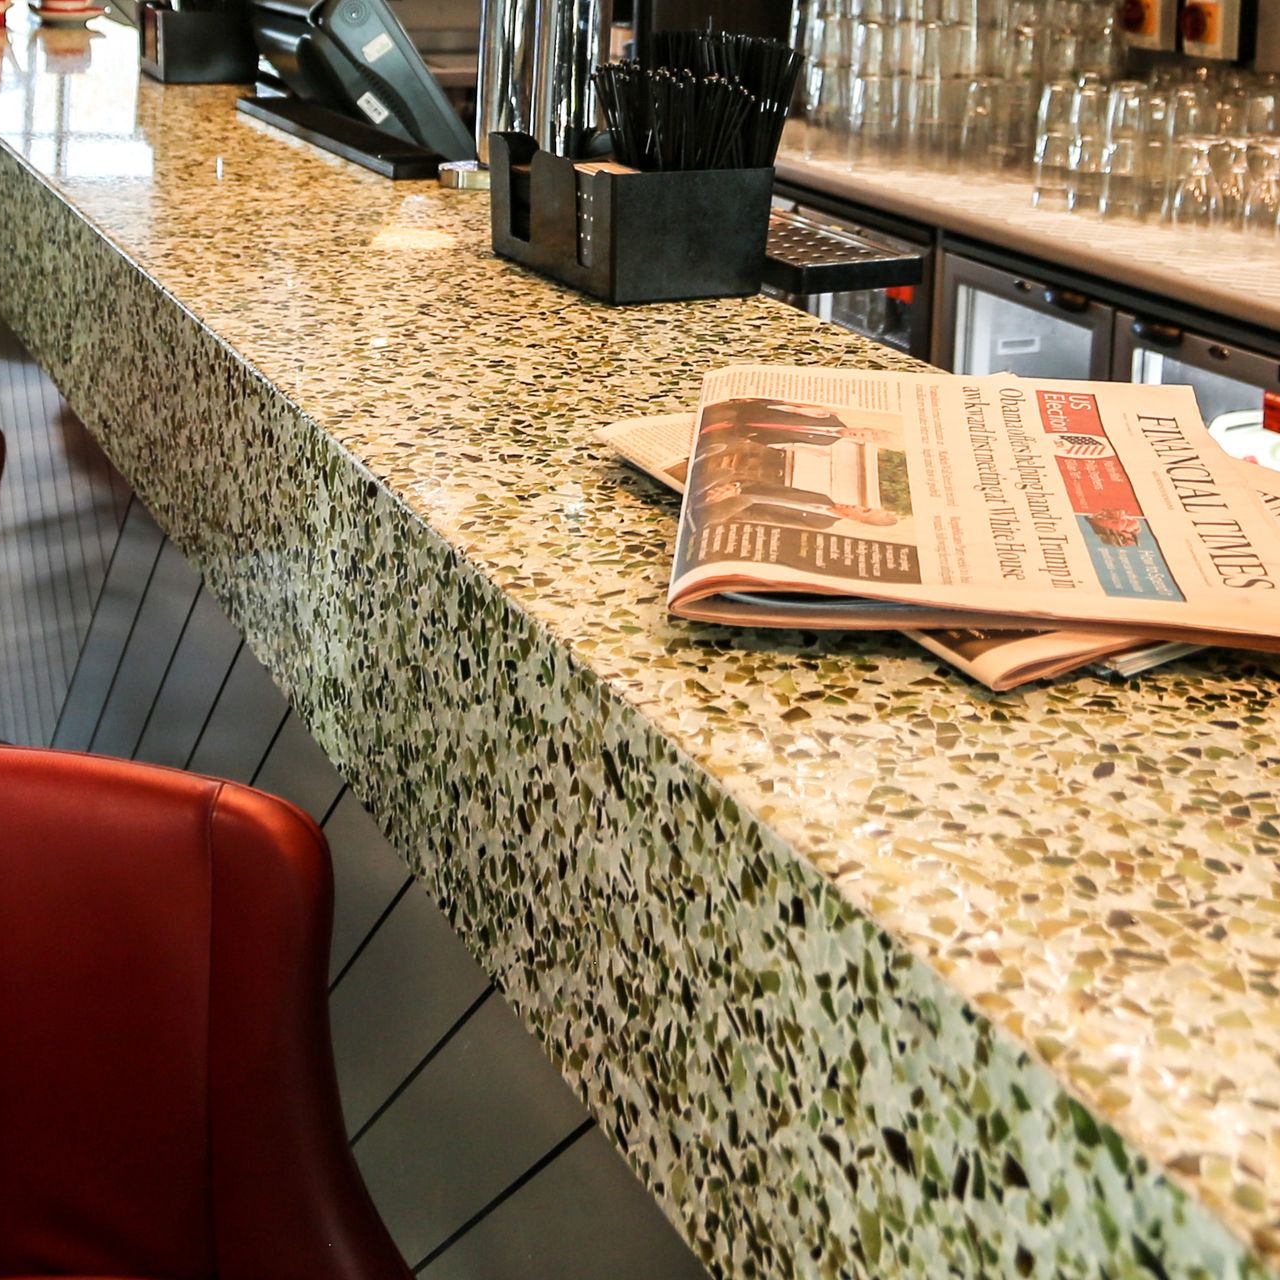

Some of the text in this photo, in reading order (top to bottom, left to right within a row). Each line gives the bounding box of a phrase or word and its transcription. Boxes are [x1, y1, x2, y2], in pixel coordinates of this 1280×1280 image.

[962, 386, 996, 433] awkward
[1043, 393, 1092, 432] US Election
[973, 453, 1007, 492] meeting
[999, 388, 1083, 588] Obama offers helping hand to Trump in
[984, 492, 1008, 504] at
[1137, 413, 1276, 590] FINANCIAL TIMES
[988, 506, 1020, 541] White
[994, 542, 1026, 580] House
